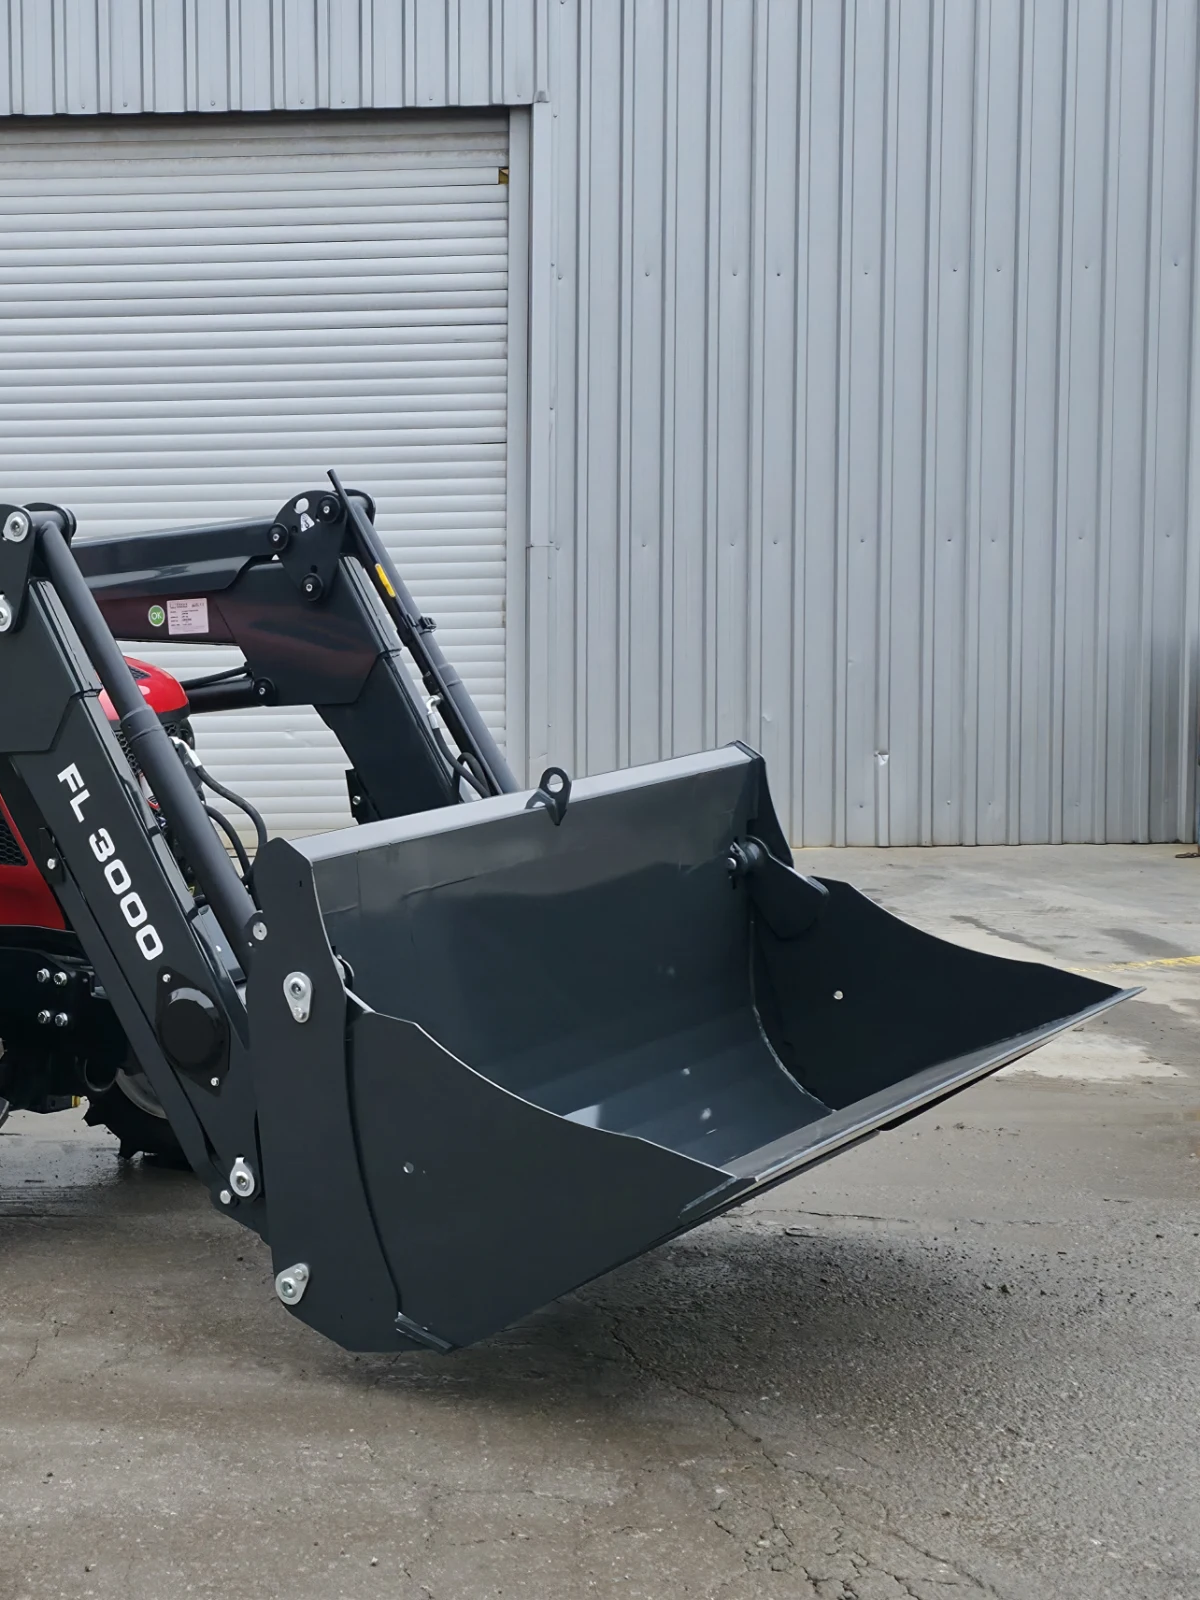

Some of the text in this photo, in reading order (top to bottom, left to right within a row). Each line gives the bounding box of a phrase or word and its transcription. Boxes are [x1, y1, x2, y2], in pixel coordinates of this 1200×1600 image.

[151, 611, 162, 621] OK
[57, 762, 164, 961] FL 3000
